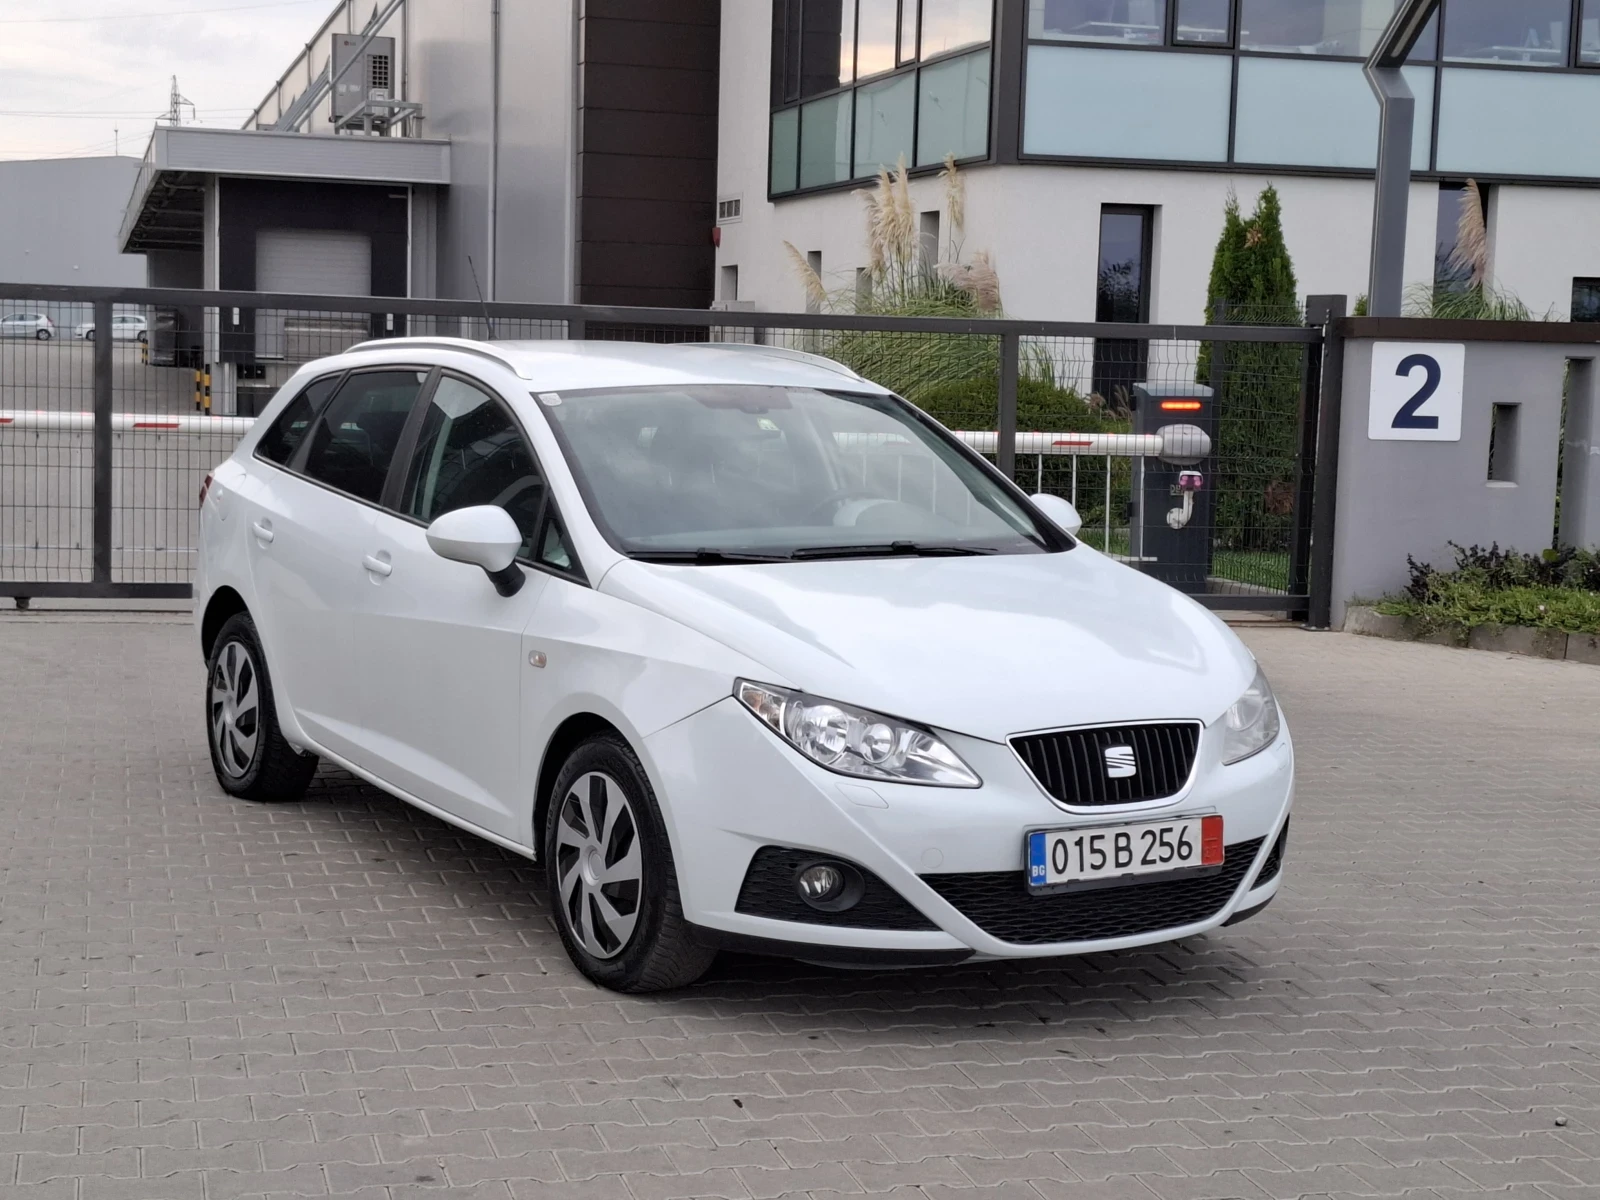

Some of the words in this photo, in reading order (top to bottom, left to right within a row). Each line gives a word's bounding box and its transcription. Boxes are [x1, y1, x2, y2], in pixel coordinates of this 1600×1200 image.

[1391, 353, 1441, 429] 2
[1032, 865, 1045, 877] BG
[1052, 834, 1107, 875] 015
[1115, 832, 1133, 868] B
[1141, 825, 1193, 866] 256
